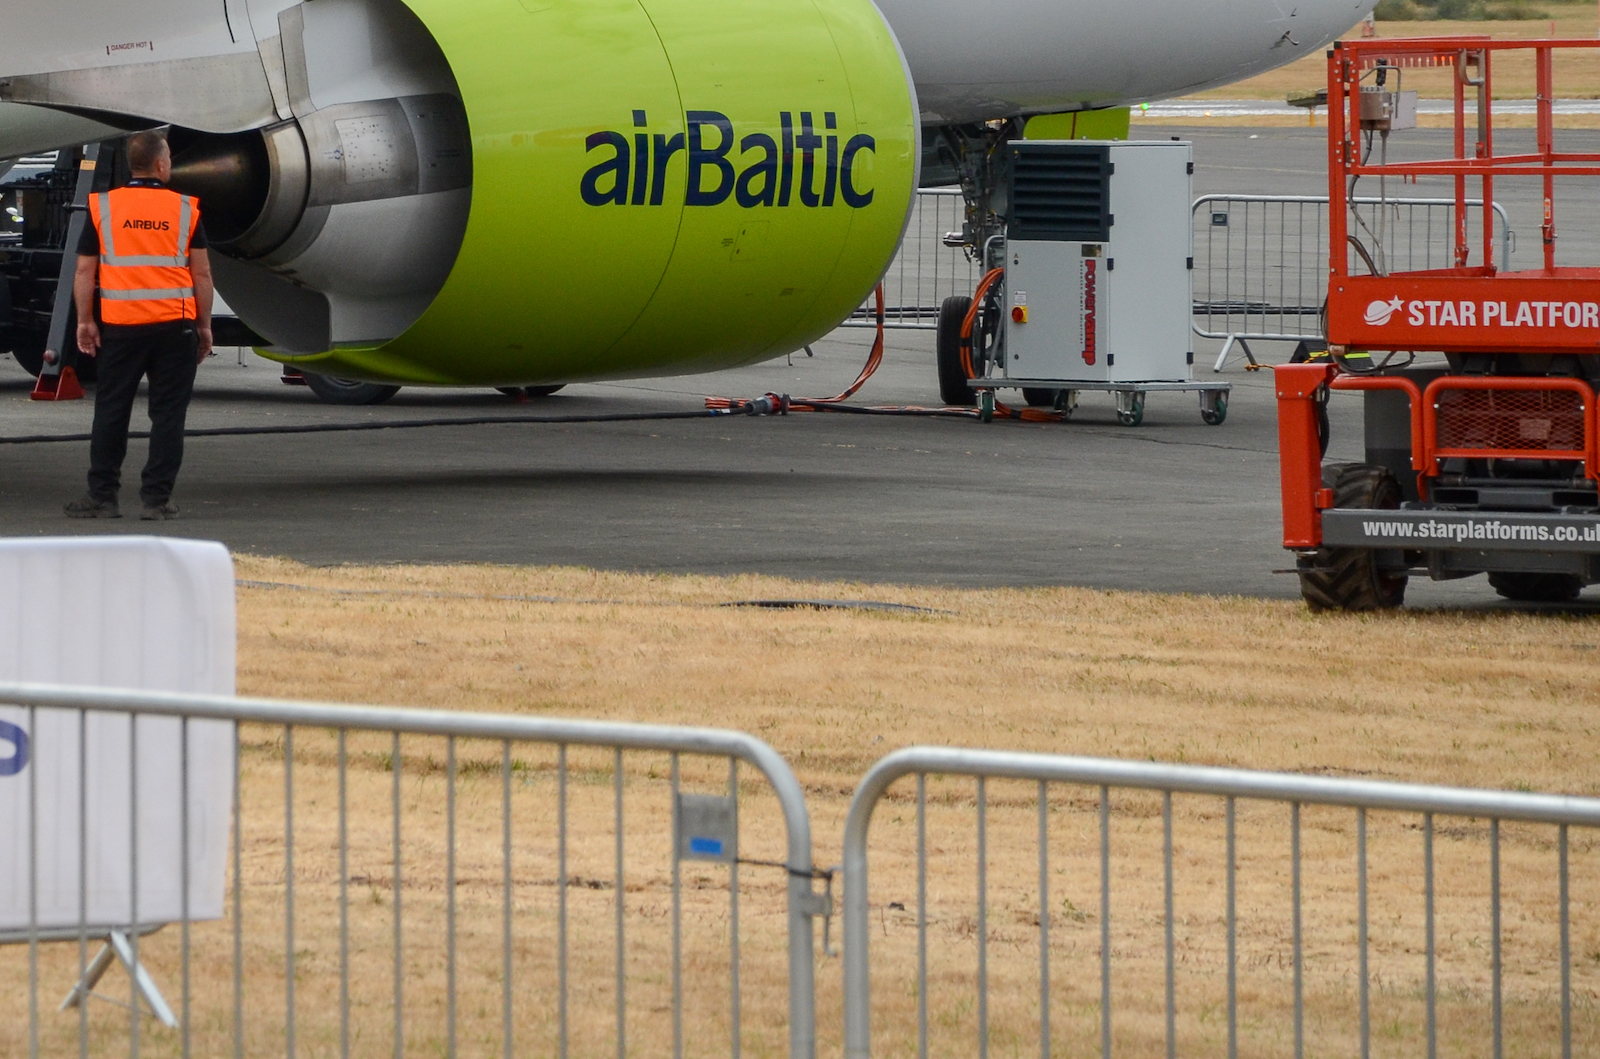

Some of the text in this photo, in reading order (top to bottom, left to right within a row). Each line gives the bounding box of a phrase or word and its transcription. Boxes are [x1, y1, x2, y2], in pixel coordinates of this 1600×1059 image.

[111, 42, 135, 51] DANGER
[580, 109, 877, 209] airBaltic
[123, 219, 170, 231] AIRBUS
[1408, 300, 1476, 327] STAR
